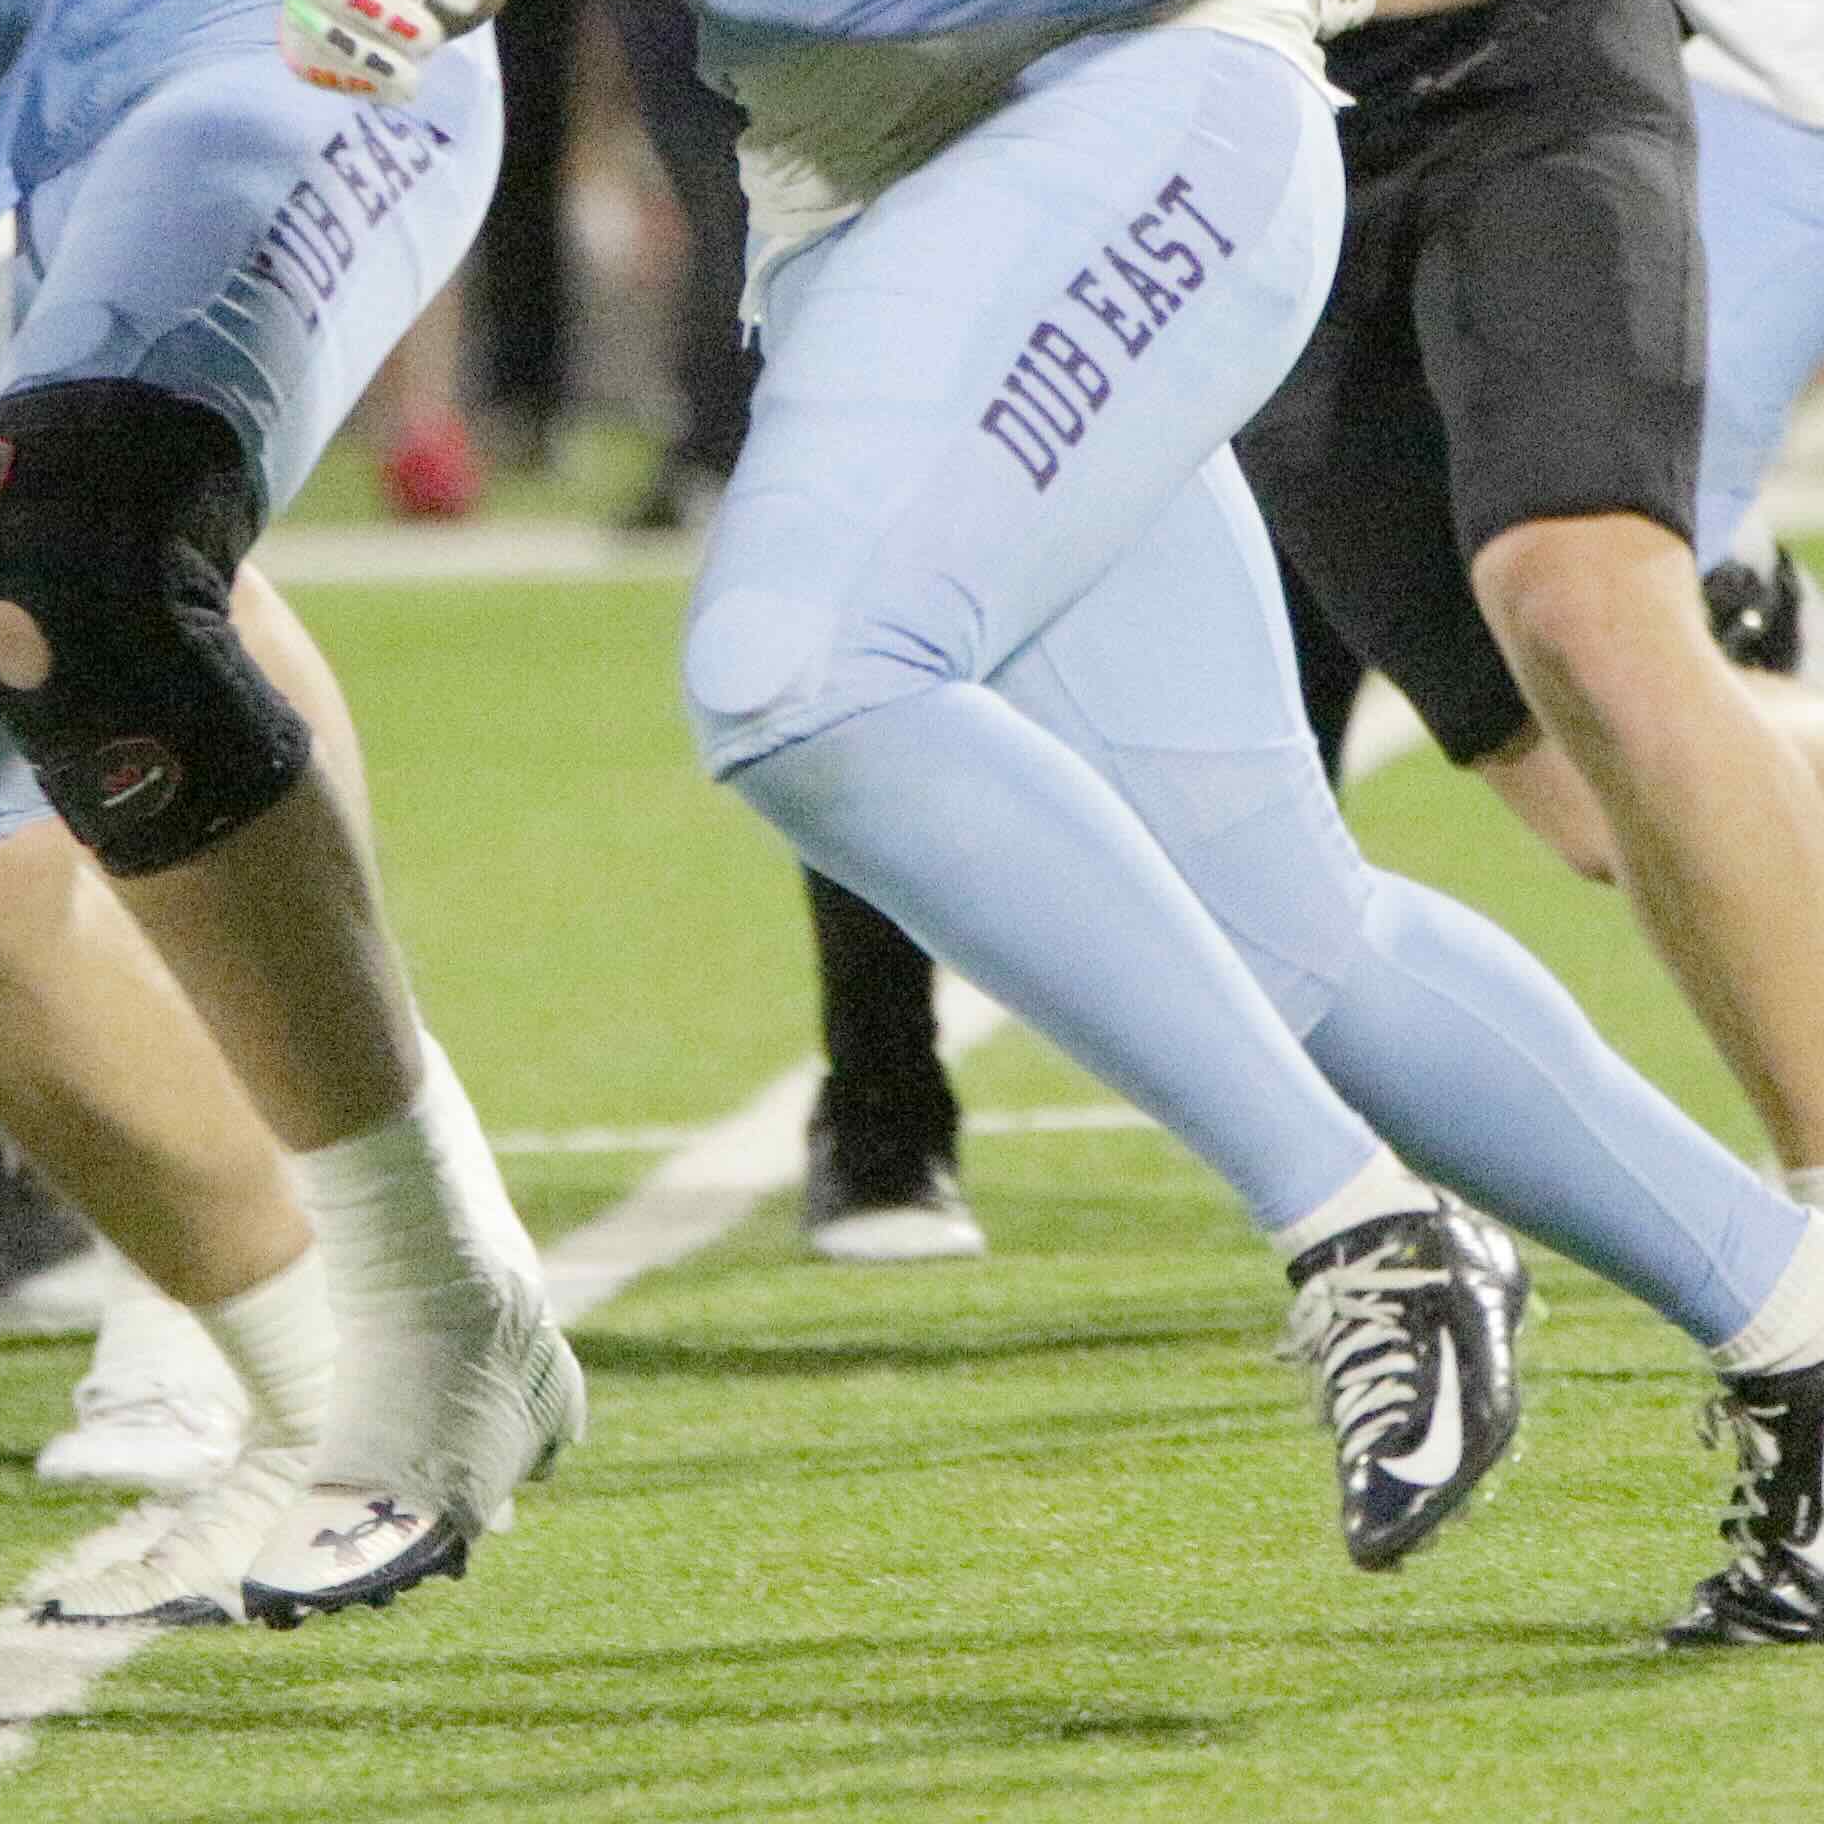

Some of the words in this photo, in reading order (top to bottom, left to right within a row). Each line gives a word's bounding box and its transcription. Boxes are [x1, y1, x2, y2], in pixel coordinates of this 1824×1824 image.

[321, 99, 451, 228] EAS
[979, 321, 1112, 495] DUB
[1066, 172, 1236, 360] EAST
